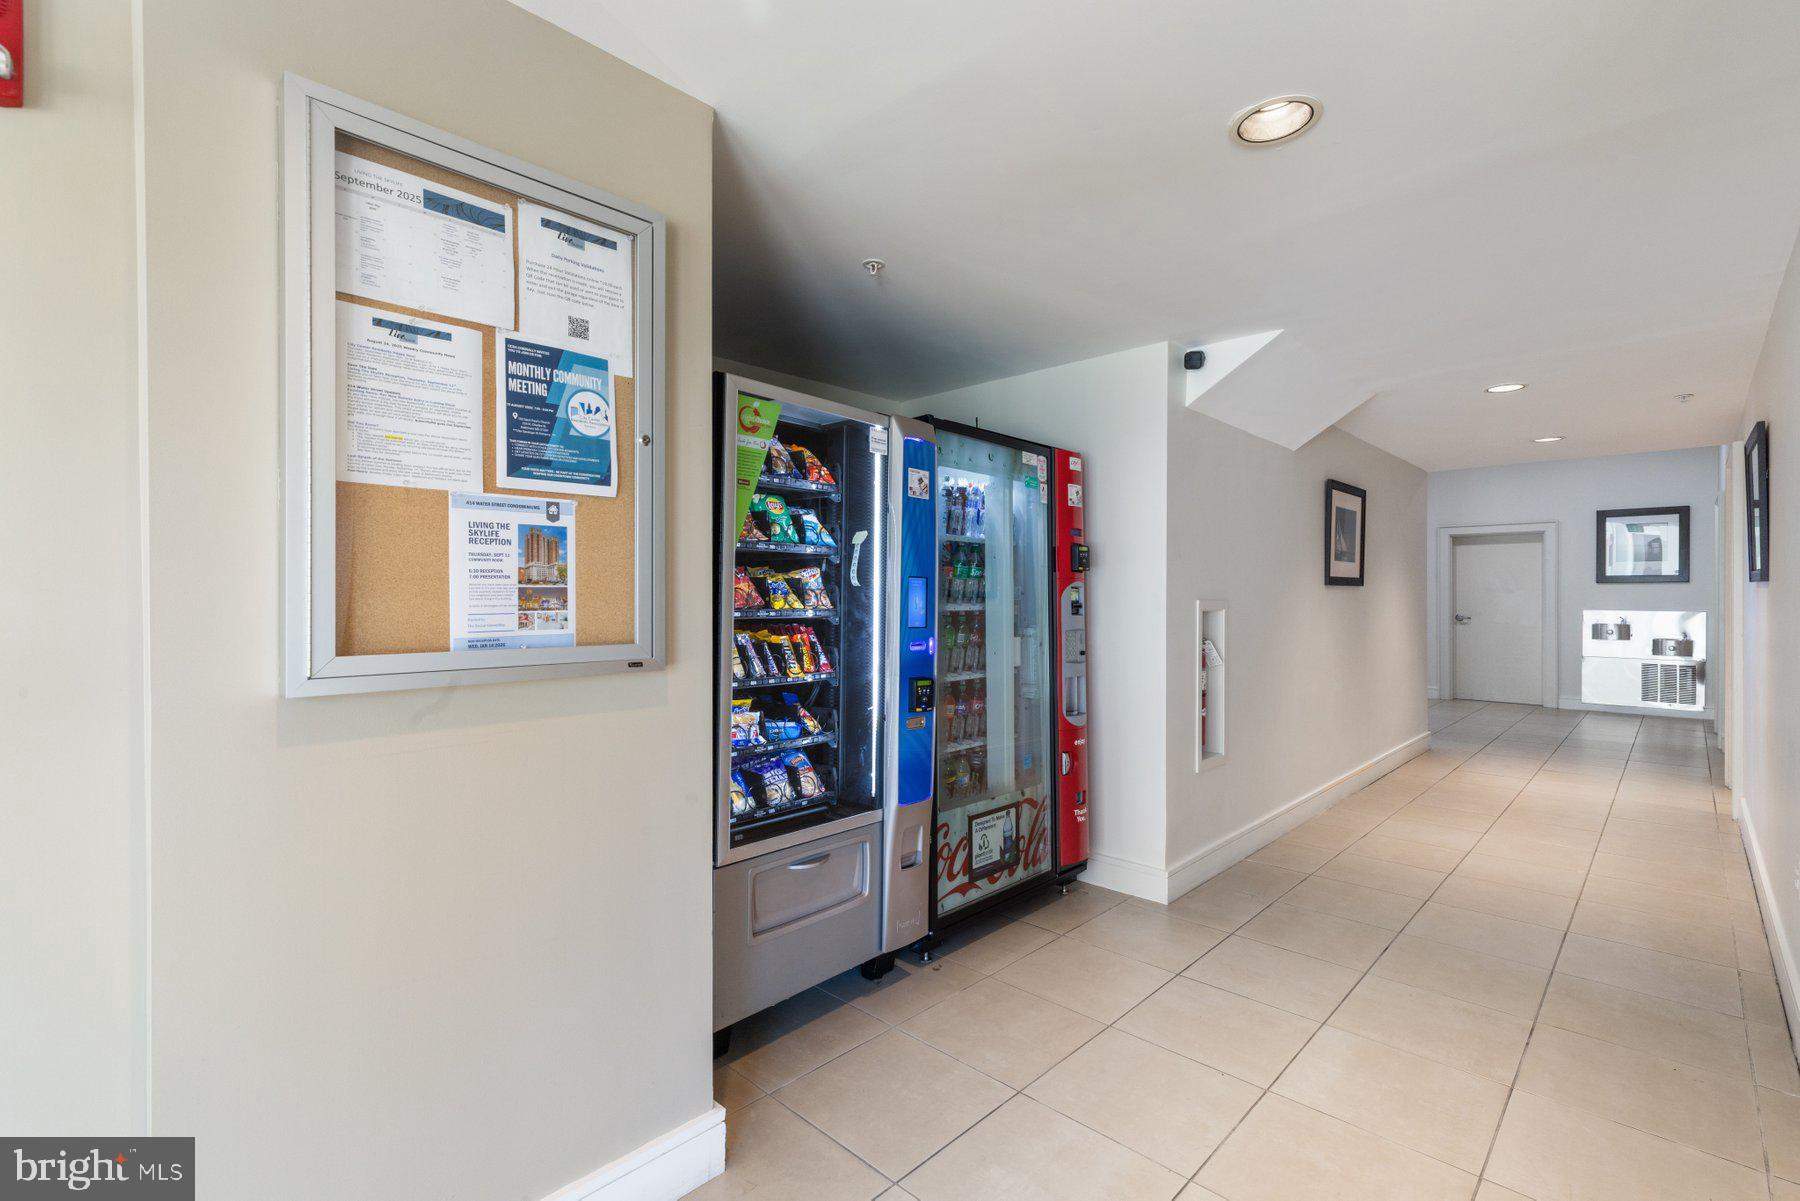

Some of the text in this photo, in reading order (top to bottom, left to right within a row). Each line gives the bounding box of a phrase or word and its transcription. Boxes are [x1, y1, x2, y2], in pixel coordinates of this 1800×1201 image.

[334, 170, 394, 196] September
[397, 189, 422, 204] 2025
[508, 360, 602, 390] MONTHLY COMMUNITY
[508, 377, 548, 397] MEETING
[468, 521, 511, 530] LIVING THE
[468, 529, 500, 538] SKYLIFE
[468, 537, 512, 546] RECEPTION
[975, 819, 991, 827] Designed
[978, 823, 996, 833] Difference
